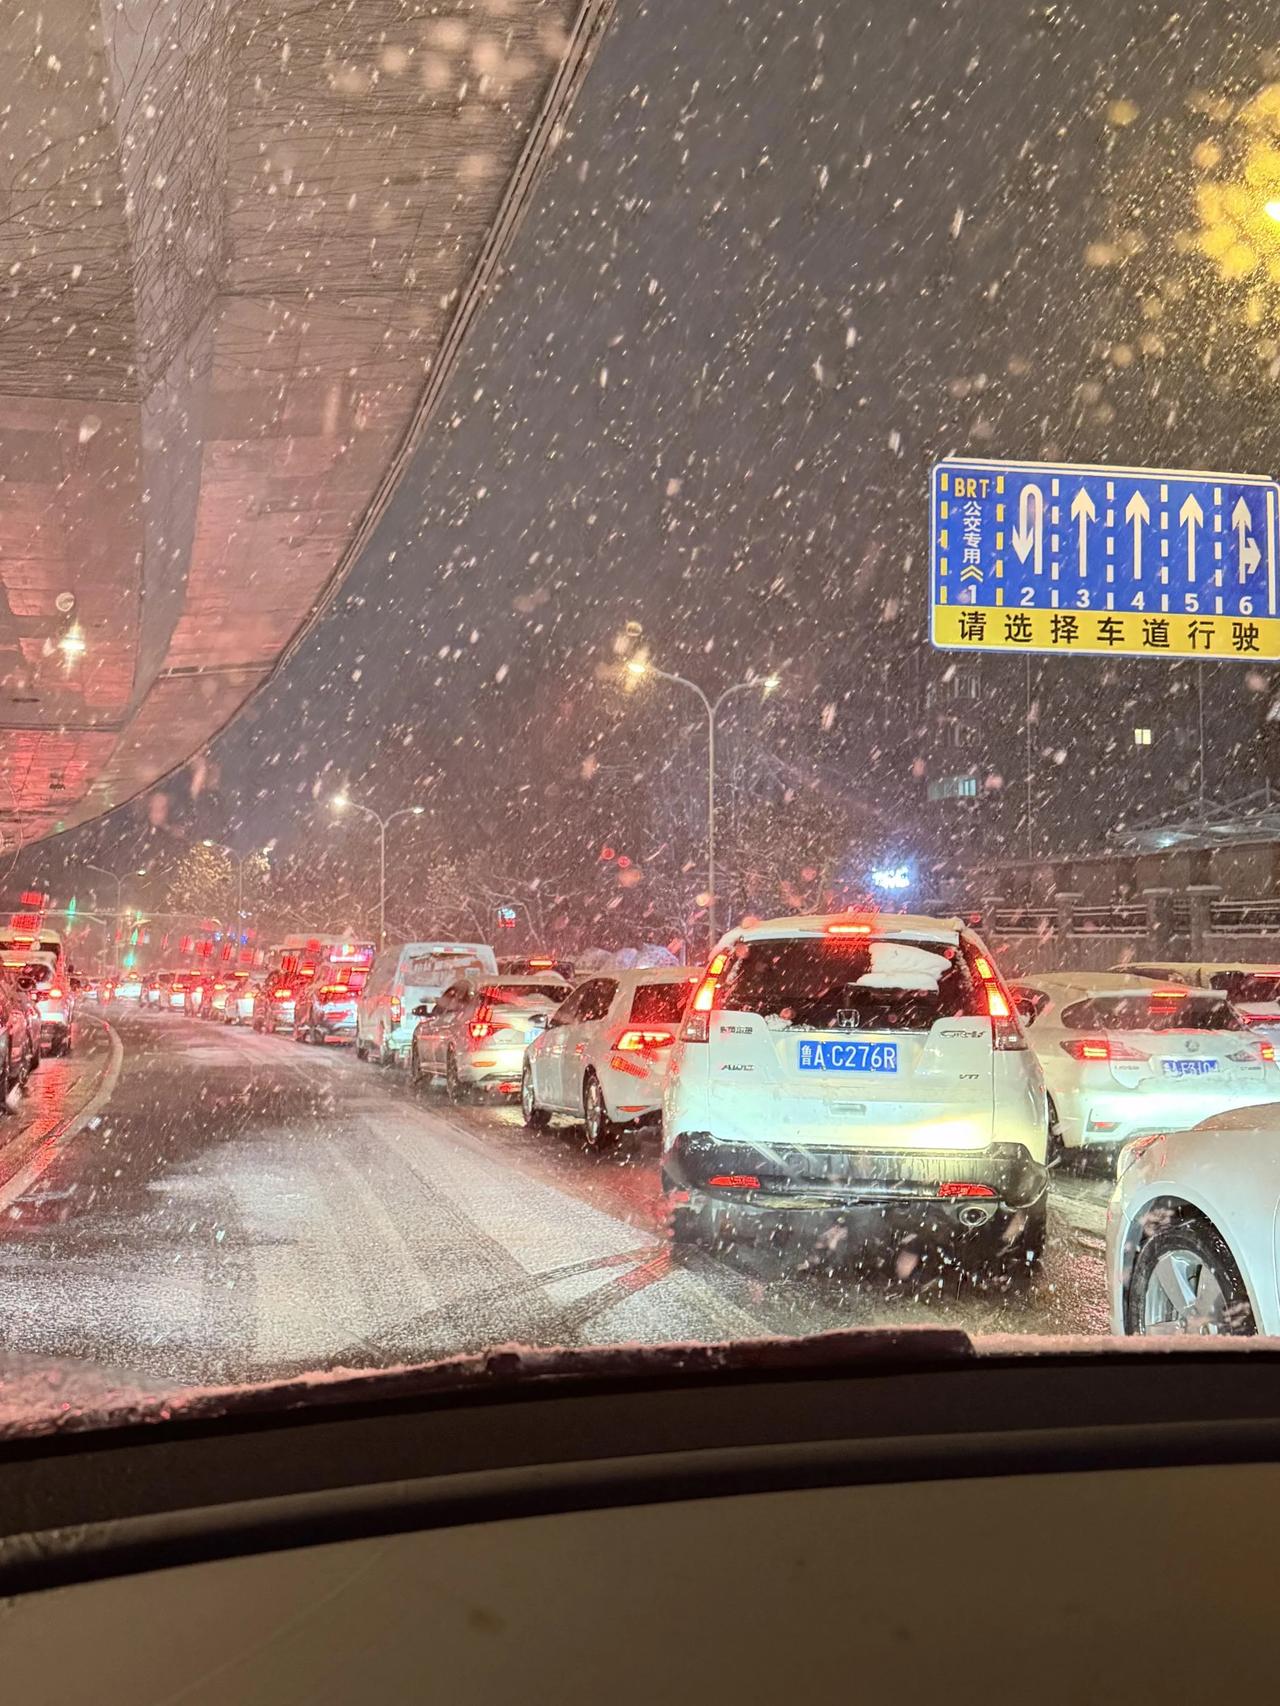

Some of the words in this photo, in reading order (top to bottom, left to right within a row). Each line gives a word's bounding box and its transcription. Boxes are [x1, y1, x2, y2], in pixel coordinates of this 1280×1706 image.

[955, 477, 989, 498] BRT
[963, 500, 982, 564] 公交专用
[967, 584, 977, 604] 1
[1020, 587, 1035, 606] 2
[1076, 589, 1090, 608] 3
[1131, 591, 1145, 611] 4
[1185, 593, 1199, 612] 5
[1239, 596, 1253, 615] 6
[959, 611, 1260, 652] 请选择车道行驶
